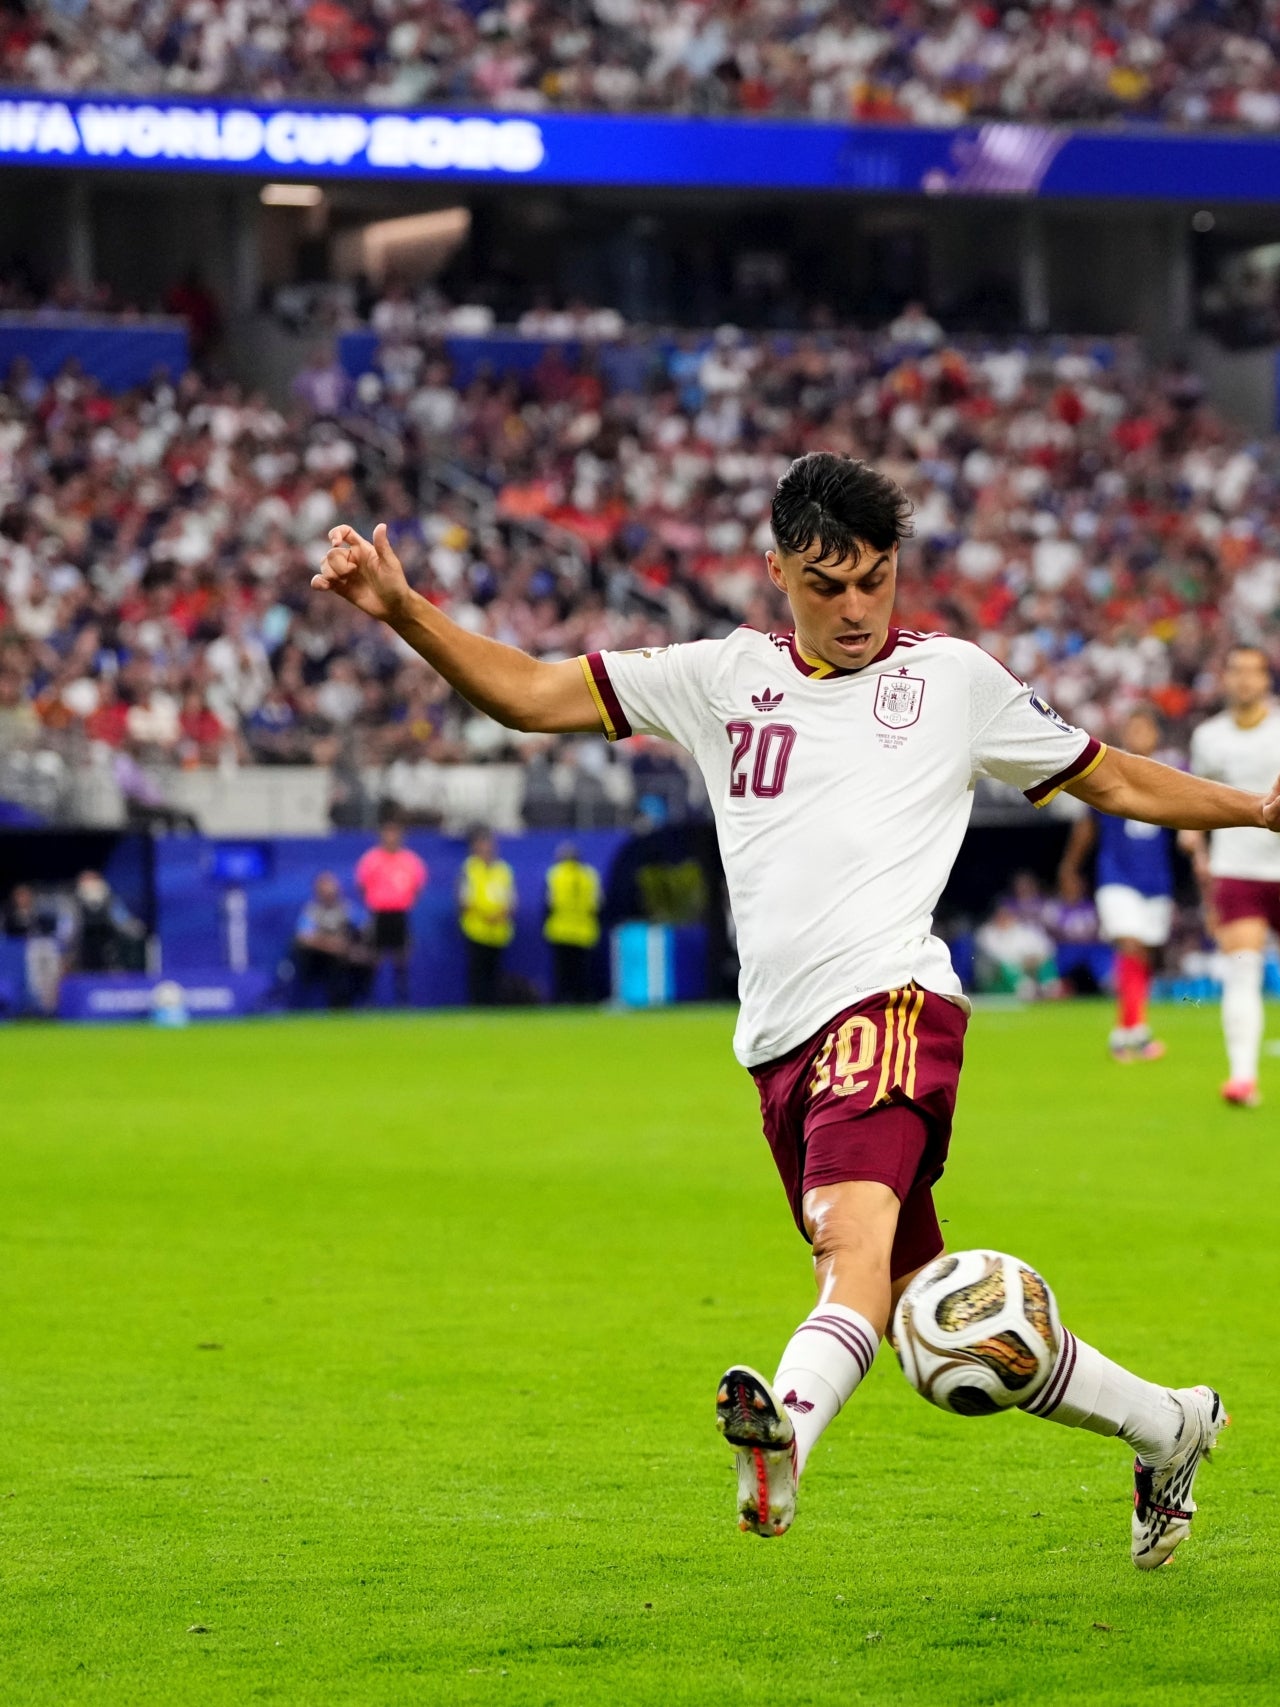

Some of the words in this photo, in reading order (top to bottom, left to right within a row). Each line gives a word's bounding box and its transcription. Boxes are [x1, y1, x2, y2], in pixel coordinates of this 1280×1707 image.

[0, 100, 79, 155] IFA
[79, 103, 263, 161] WORLD
[264, 112, 368, 164] CUP
[726, 721, 797, 799] 20
